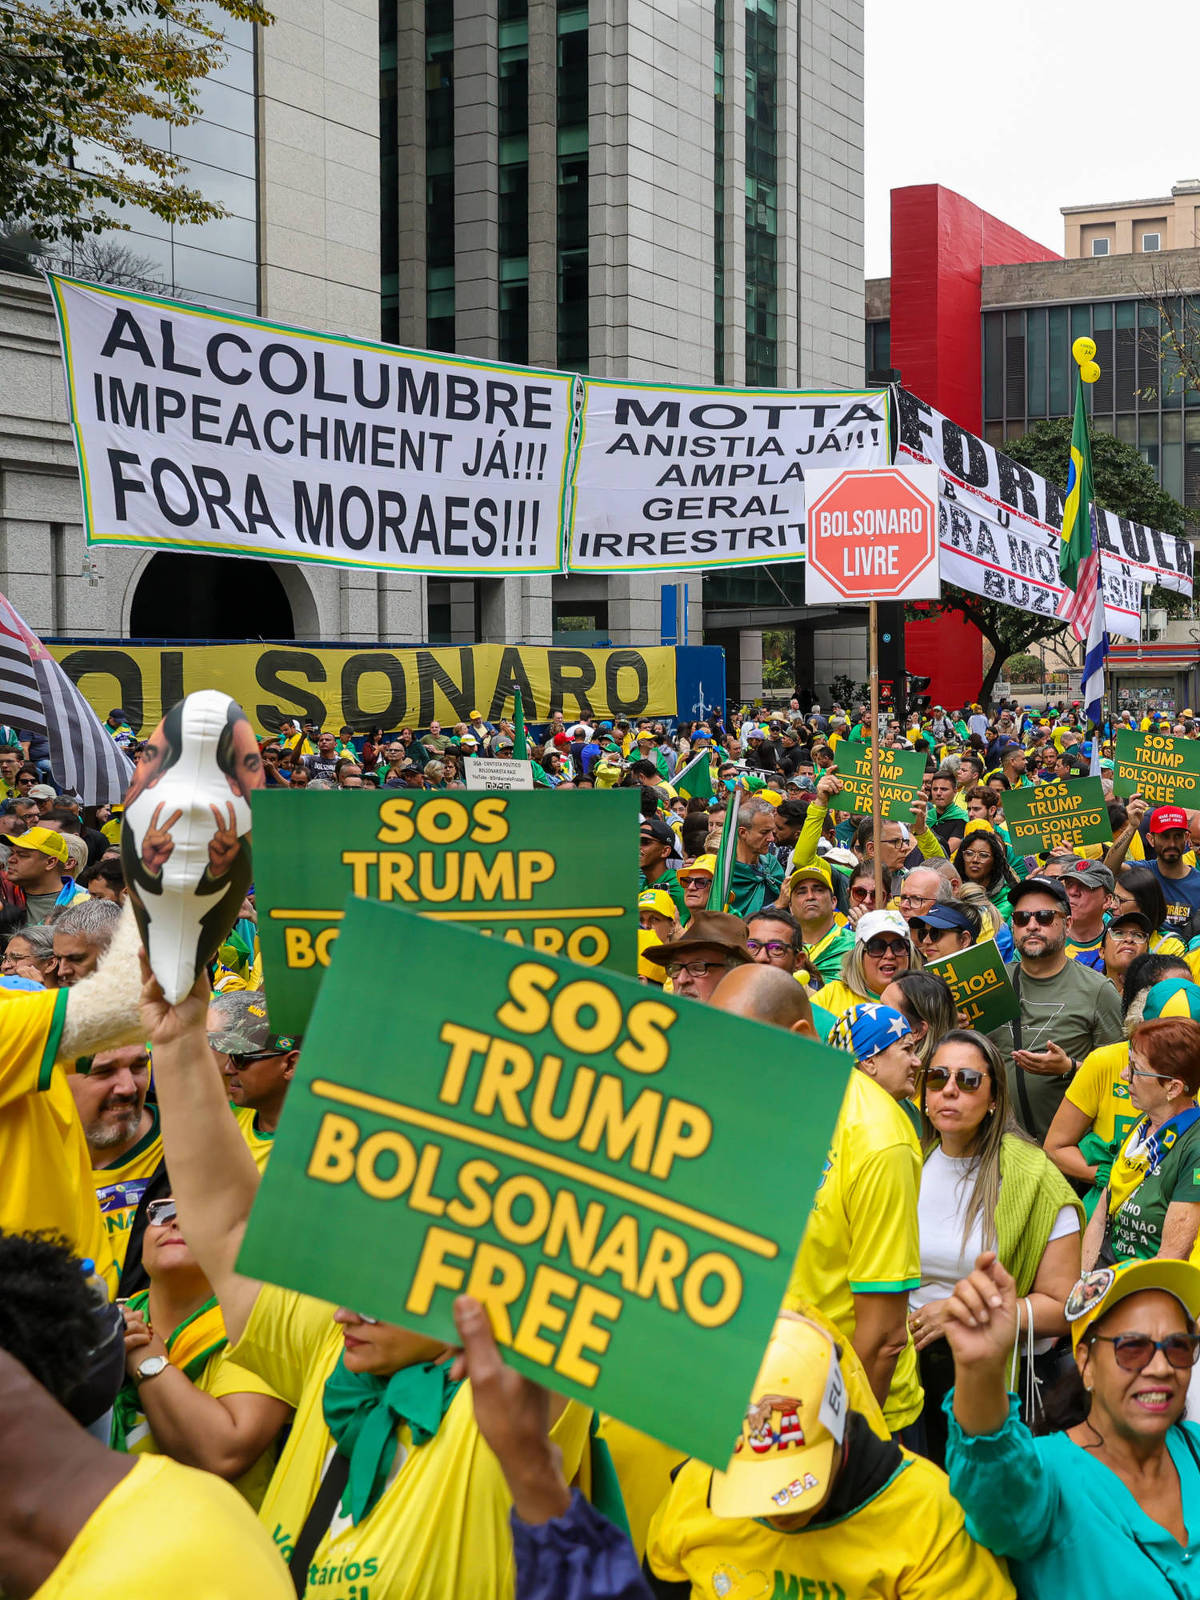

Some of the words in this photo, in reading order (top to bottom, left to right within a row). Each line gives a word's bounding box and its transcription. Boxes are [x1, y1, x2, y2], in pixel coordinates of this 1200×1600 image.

[100, 309, 553, 429] ALCOLUMBRE
[94, 374, 452, 473] IMPEACHMENT
[462, 431, 546, 481] JÁ!!!
[614, 399, 883, 430] MOTTA
[606, 432, 784, 458] ANISTIA
[796, 424, 880, 456] JÁ!!!
[655, 463, 806, 486] AMPLA
[107, 449, 284, 540] FORA
[294, 480, 540, 559] MORAES!!!
[642, 495, 790, 521] GERAL
[578, 521, 806, 557] IRRESTRIT
[820, 508, 922, 538] BOLSONARO
[1099, 509, 1192, 577] LULA
[843, 545, 900, 577] LIVRE
[61, 649, 649, 735] OLSONARO
[1135, 747, 1184, 768] TRUMP
[1143, 734, 1174, 751] SOS
[1034, 783, 1068, 800] SOS
[1119, 765, 1196, 790] BOLSONARO
[1136, 782, 1175, 803] FREE
[377, 797, 510, 845] SOS
[854, 796, 891, 817] FRE
[1026, 795, 1082, 816] TRUMP
[1015, 813, 1102, 837] BOLSONARO
[1041, 829, 1084, 849] FREE
[342, 849, 557, 902] TRUMP
[496, 960, 678, 1075] SOS
[439, 1021, 714, 1181] TRUMP
[307, 1112, 745, 1329] BOLSONARO
[1132, 1220, 1157, 1234] NÃO
[405, 1223, 624, 1390] FREE
[771, 1472, 819, 1507] USA
